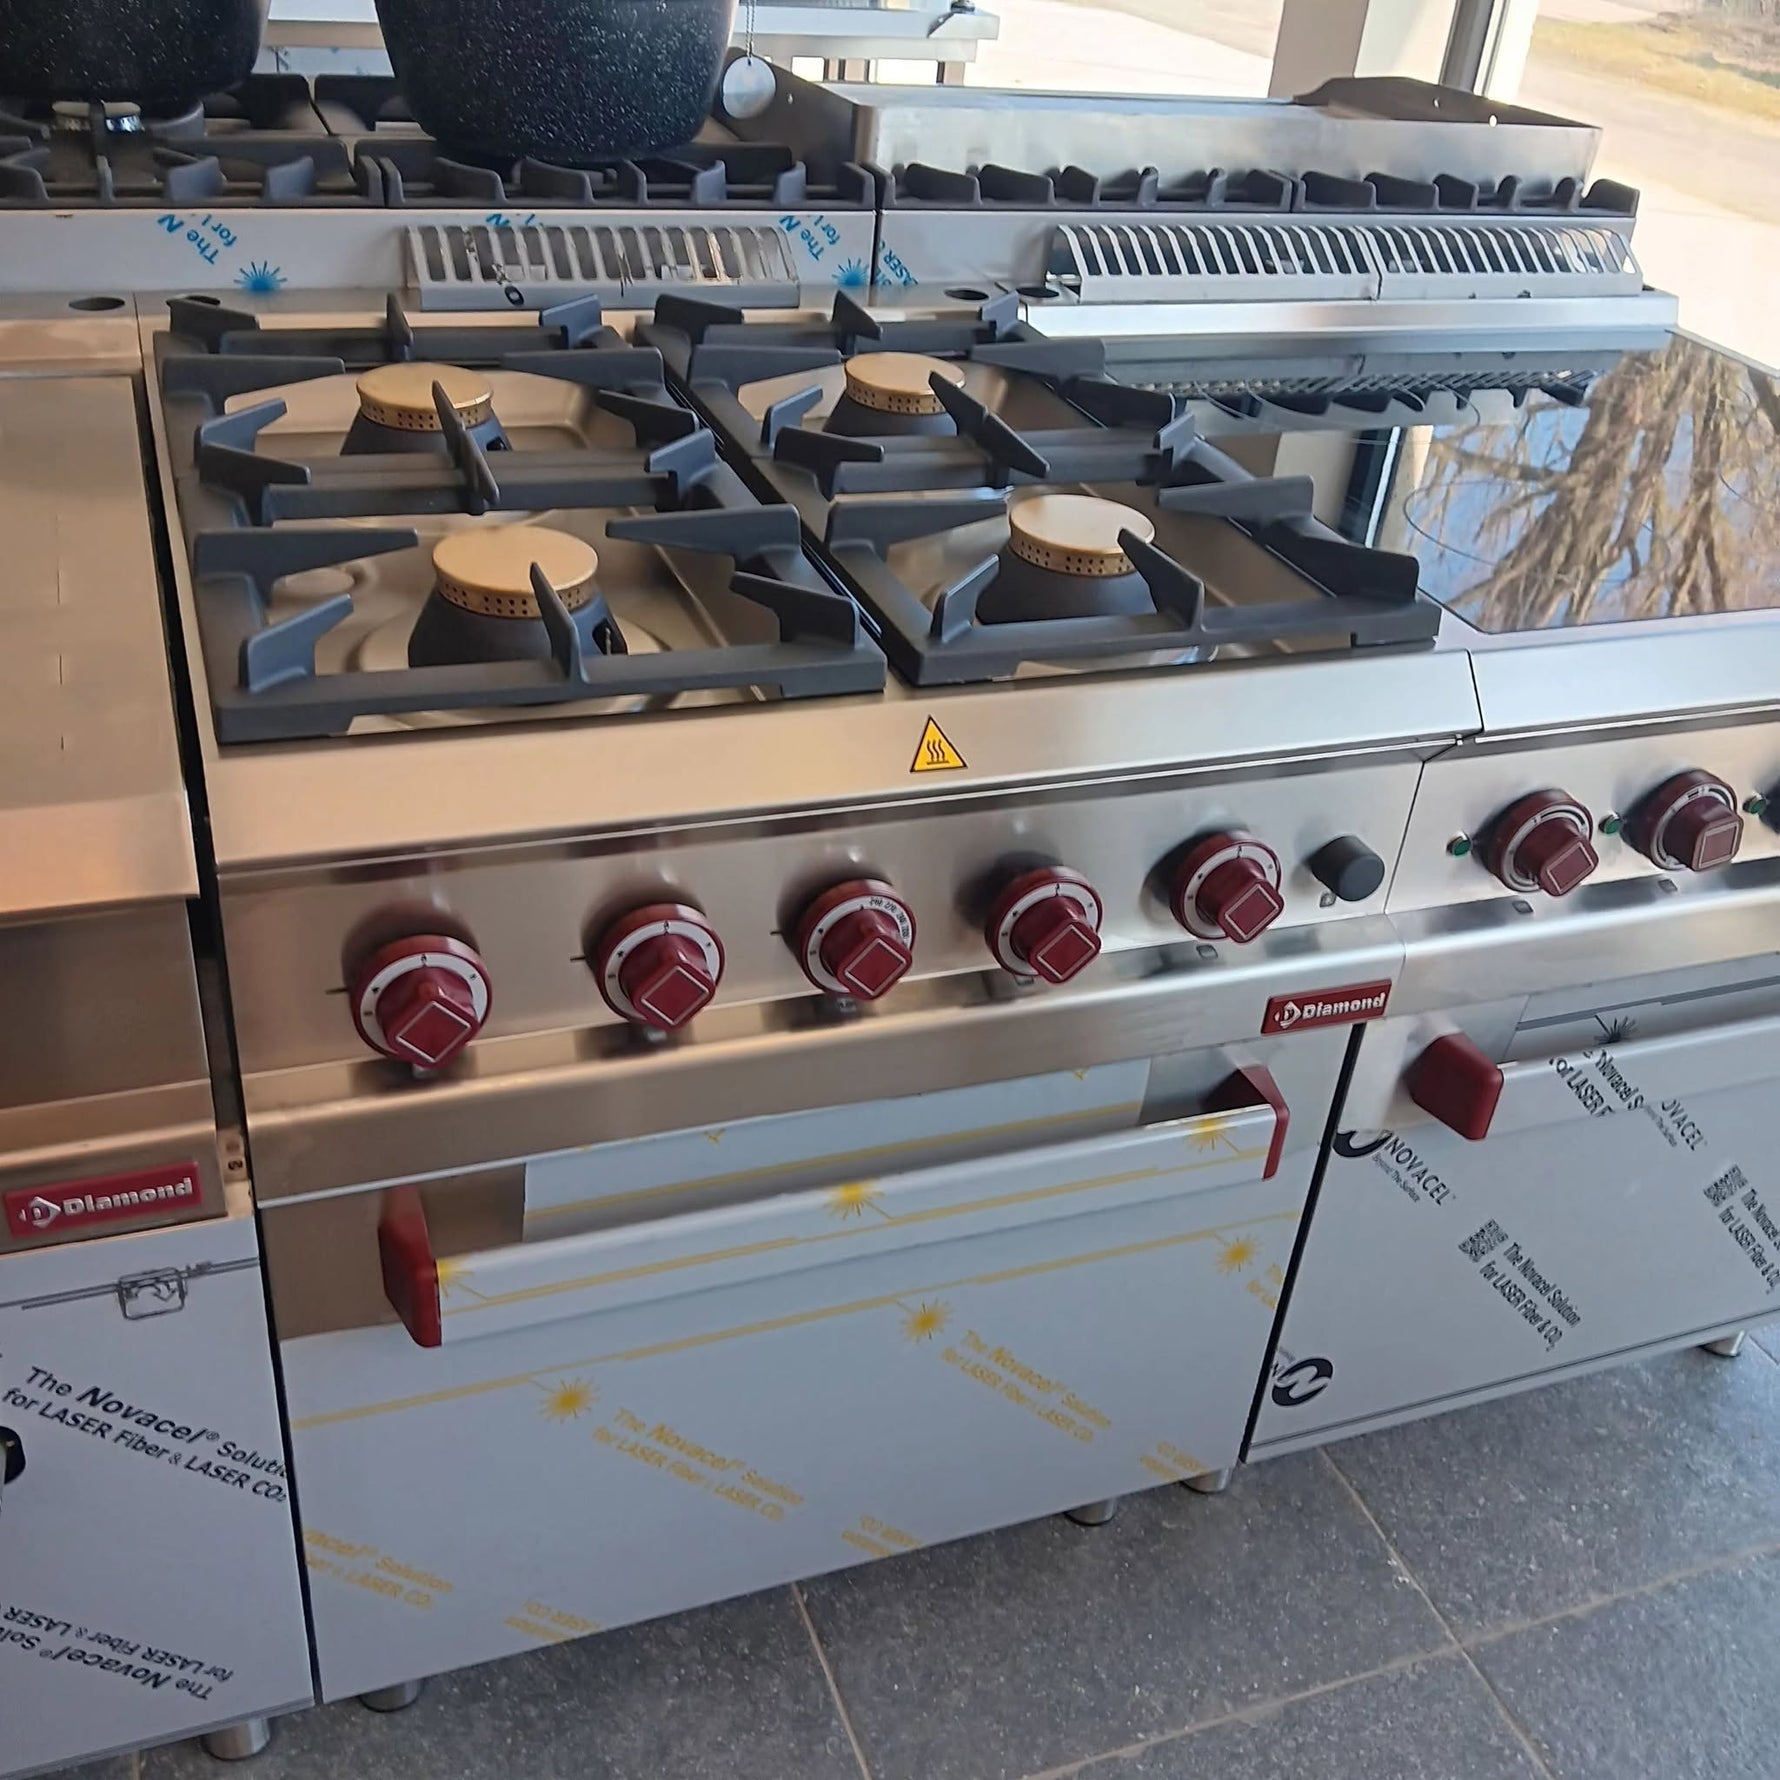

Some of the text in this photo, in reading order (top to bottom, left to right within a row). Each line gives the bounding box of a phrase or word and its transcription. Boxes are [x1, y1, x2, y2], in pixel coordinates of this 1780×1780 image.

[187, 229, 219, 265] The
[211, 223, 237, 247] for
[800, 229, 824, 261] The
[821, 223, 840, 246] for
[1303, 992, 1386, 1019] Diamond
[1567, 1070, 1605, 1117] LASER
[63, 1177, 193, 1216] Diamond
[1480, 1260, 1499, 1282] for
[1493, 1273, 1526, 1309] LASER
[1503, 1242, 1581, 1328] The Novacel Solution
[26, 1366, 72, 1397] The
[2, 1387, 39, 1410] for
[39, 1401, 112, 1437] LASER
[114, 1428, 169, 1465] Fiber
[168, 1452, 182, 1466] &
[184, 1454, 251, 1490] LASER
[3, 1606, 72, 1636] LASER
[88, 1631, 141, 1656] Fiber
[142, 1646, 205, 1671] LASER
[175, 1677, 213, 1700] The
[203, 1668, 234, 1682] for
